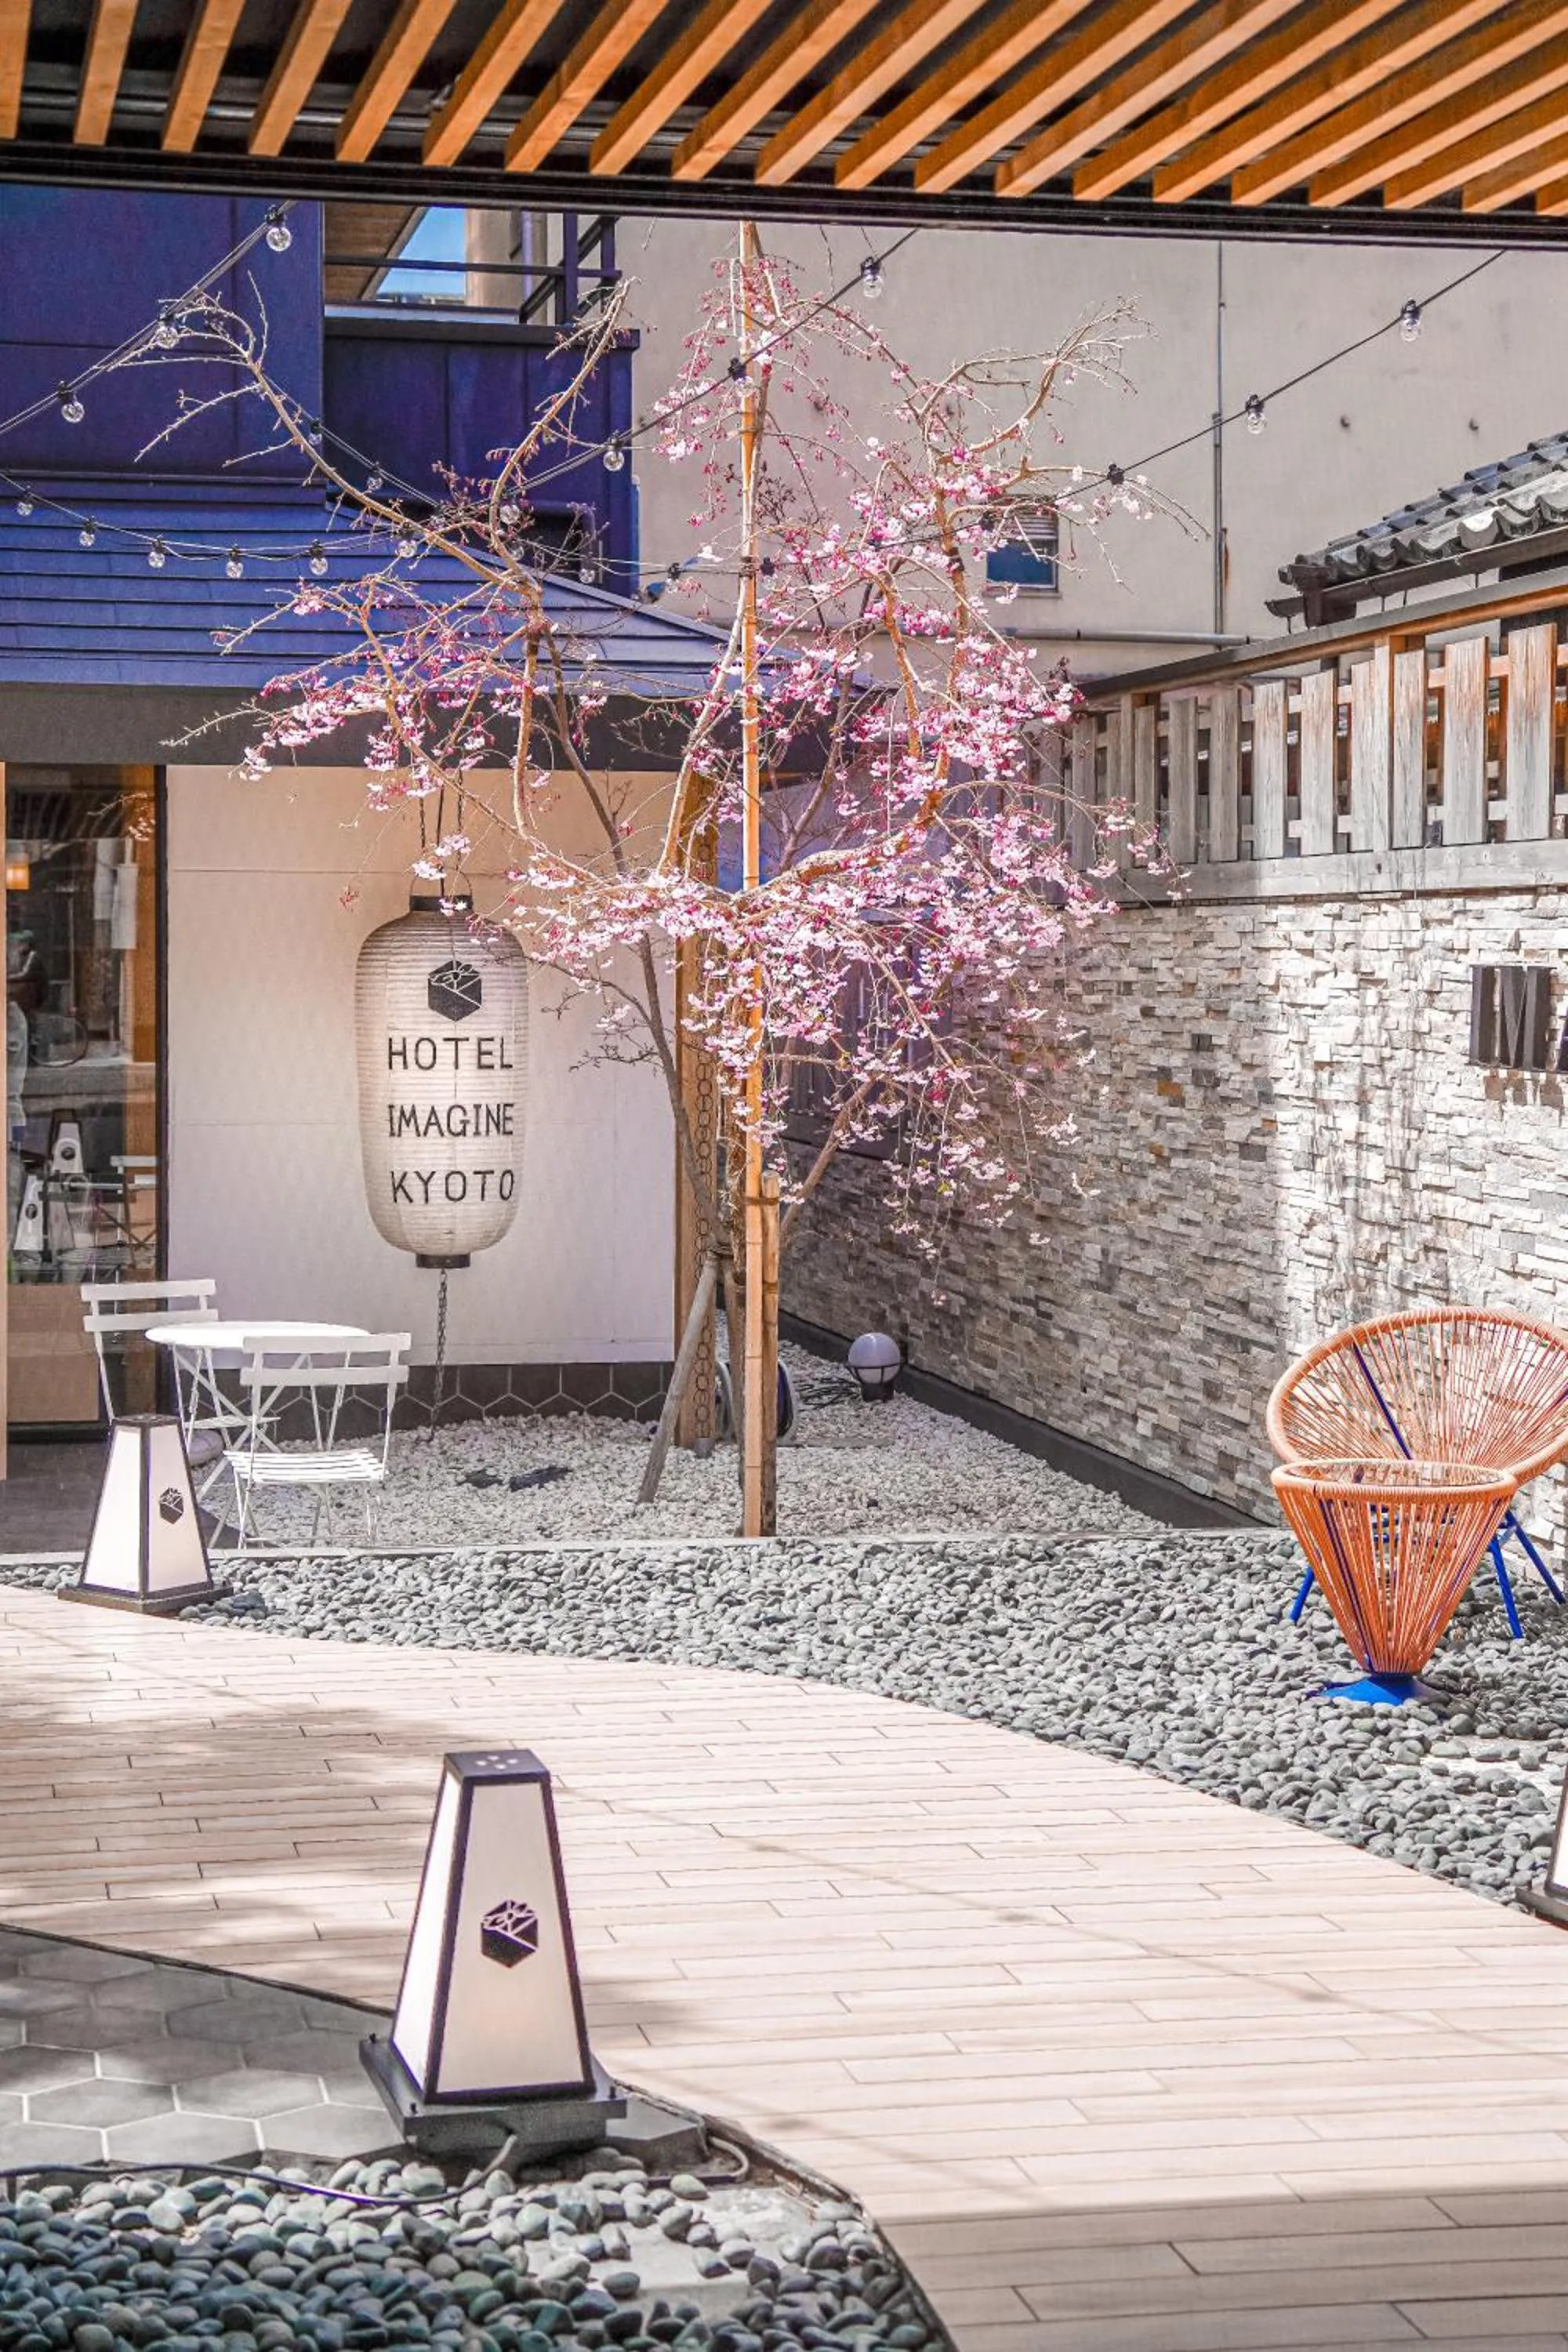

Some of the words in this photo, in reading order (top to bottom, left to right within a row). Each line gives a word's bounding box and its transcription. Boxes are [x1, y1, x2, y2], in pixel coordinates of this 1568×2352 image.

[388, 1037, 513, 1069] HOTEL
[388, 1104, 514, 1137] IMAGINE
[391, 1169, 514, 1204] KYOTO
